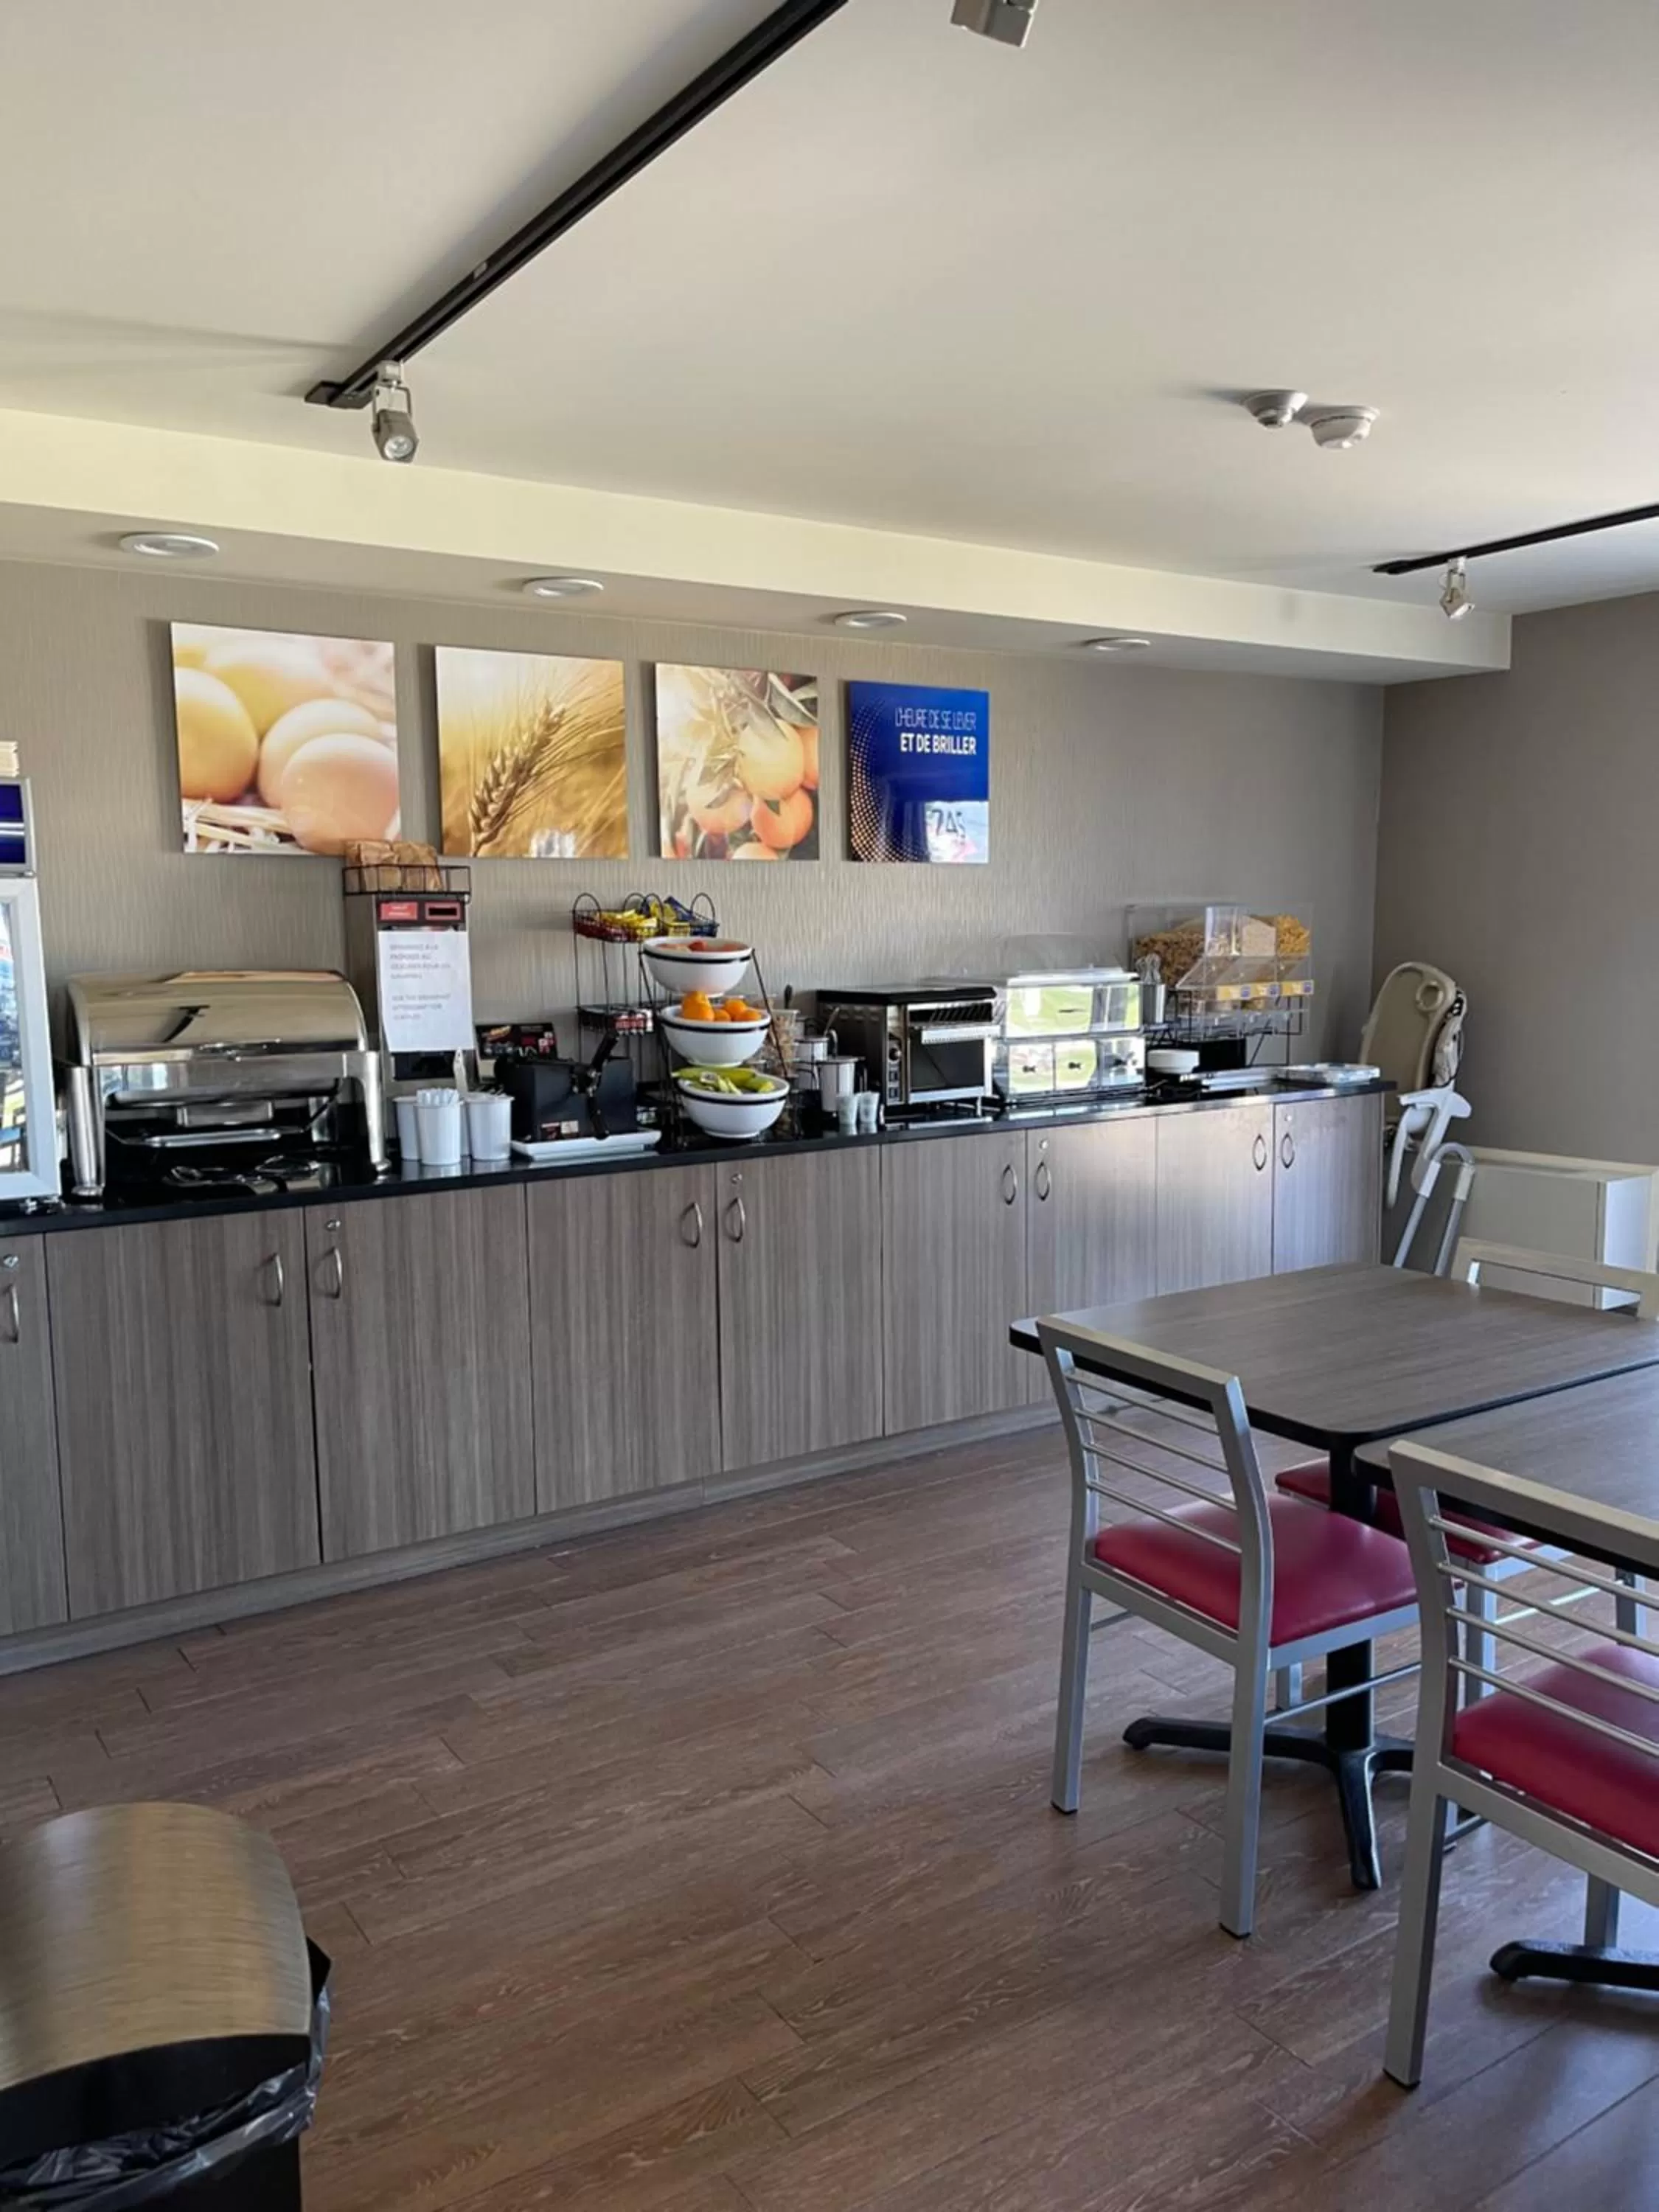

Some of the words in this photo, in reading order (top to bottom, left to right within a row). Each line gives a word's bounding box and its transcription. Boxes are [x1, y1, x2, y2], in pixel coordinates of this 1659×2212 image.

[928, 709, 940, 729] DE
[900, 732, 914, 752] ET
[917, 734, 931, 753] DE
[933, 734, 977, 755] BRILLER
